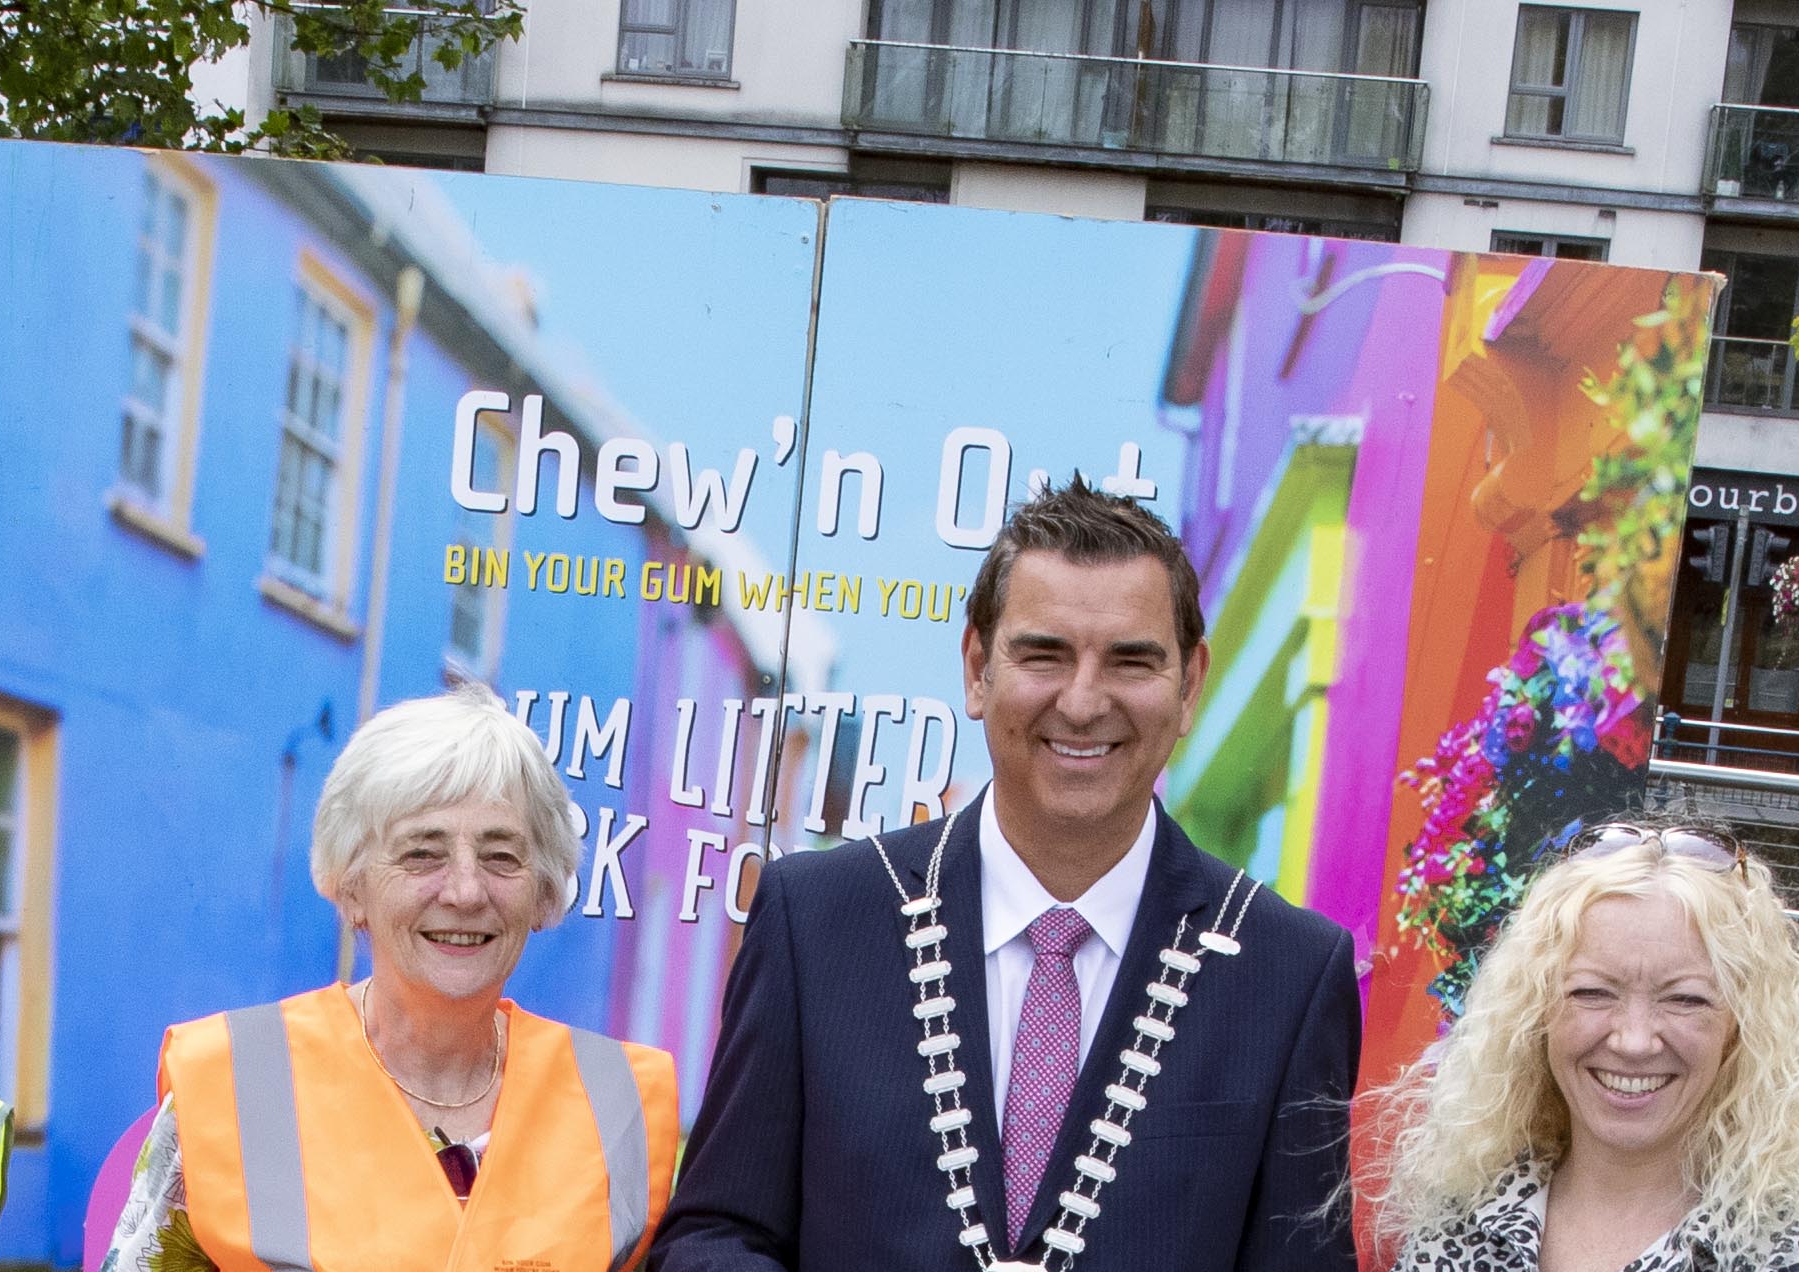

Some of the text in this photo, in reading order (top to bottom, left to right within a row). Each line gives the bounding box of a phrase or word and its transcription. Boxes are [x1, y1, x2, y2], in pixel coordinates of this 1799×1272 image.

[450, 390, 884, 539] Chew'n
[444, 544, 509, 588] BIN
[523, 550, 626, 599] YOUR
[640, 561, 722, 606] GUM
[738, 569, 862, 614] WHEN
[669, 691, 957, 841] LITTER
